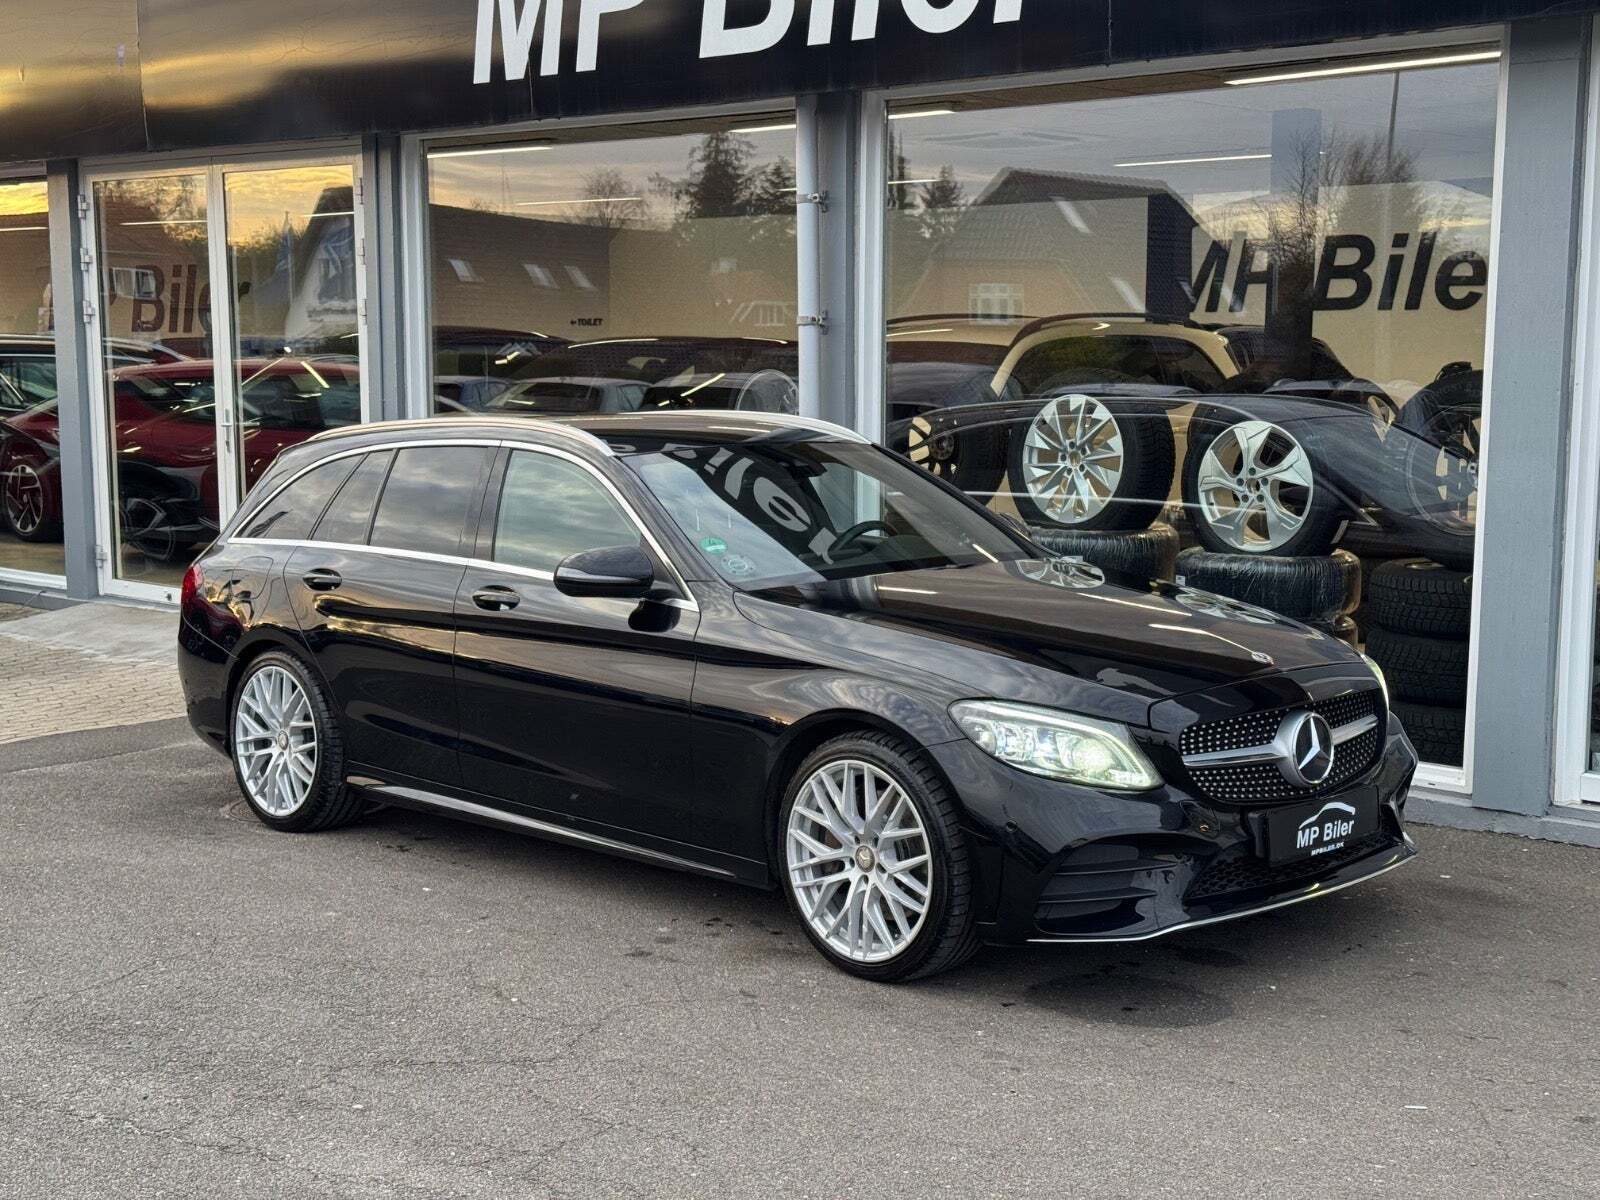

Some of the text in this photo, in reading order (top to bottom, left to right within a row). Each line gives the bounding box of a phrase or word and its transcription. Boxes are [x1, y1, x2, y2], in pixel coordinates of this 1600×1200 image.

[577, 318, 603, 326] TOILET
[1297, 819, 1354, 849] MP Biler
